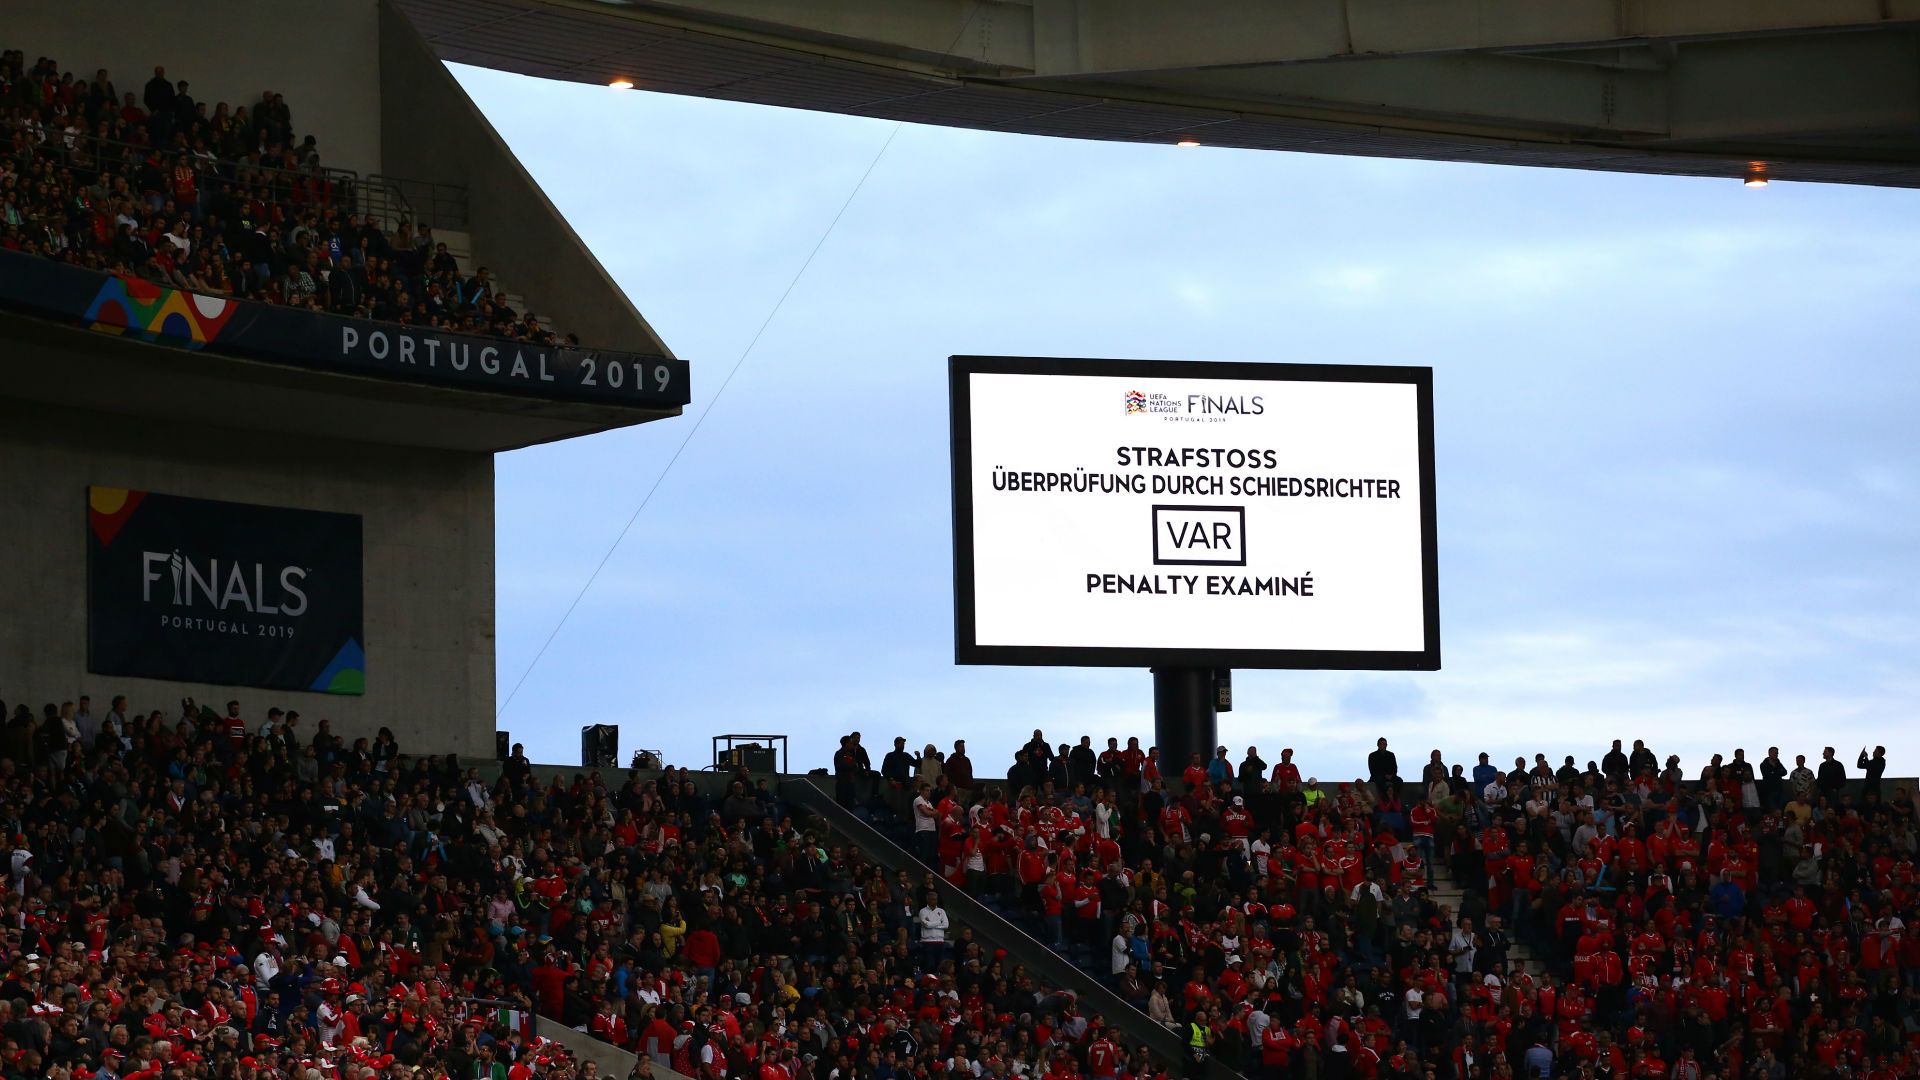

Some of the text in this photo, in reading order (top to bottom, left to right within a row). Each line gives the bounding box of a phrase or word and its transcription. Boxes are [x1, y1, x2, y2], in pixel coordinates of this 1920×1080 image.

[343, 326, 671, 393] PORTUGAL 2019
[1187, 394, 1264, 415] FINALS
[1116, 446, 1278, 470] STRAFSTOSS
[992, 465, 1401, 499] ÜBERPRÜFUNG DURCH SCHIEDSRICHTER
[1166, 521, 1232, 550] VAR
[143, 549, 308, 617] FINALS
[1086, 571, 1314, 597] PENALTY EXAMINÉ
[161, 614, 295, 639] PORTUGAL 2019
[1095, 1050, 1105, 1066] 7
